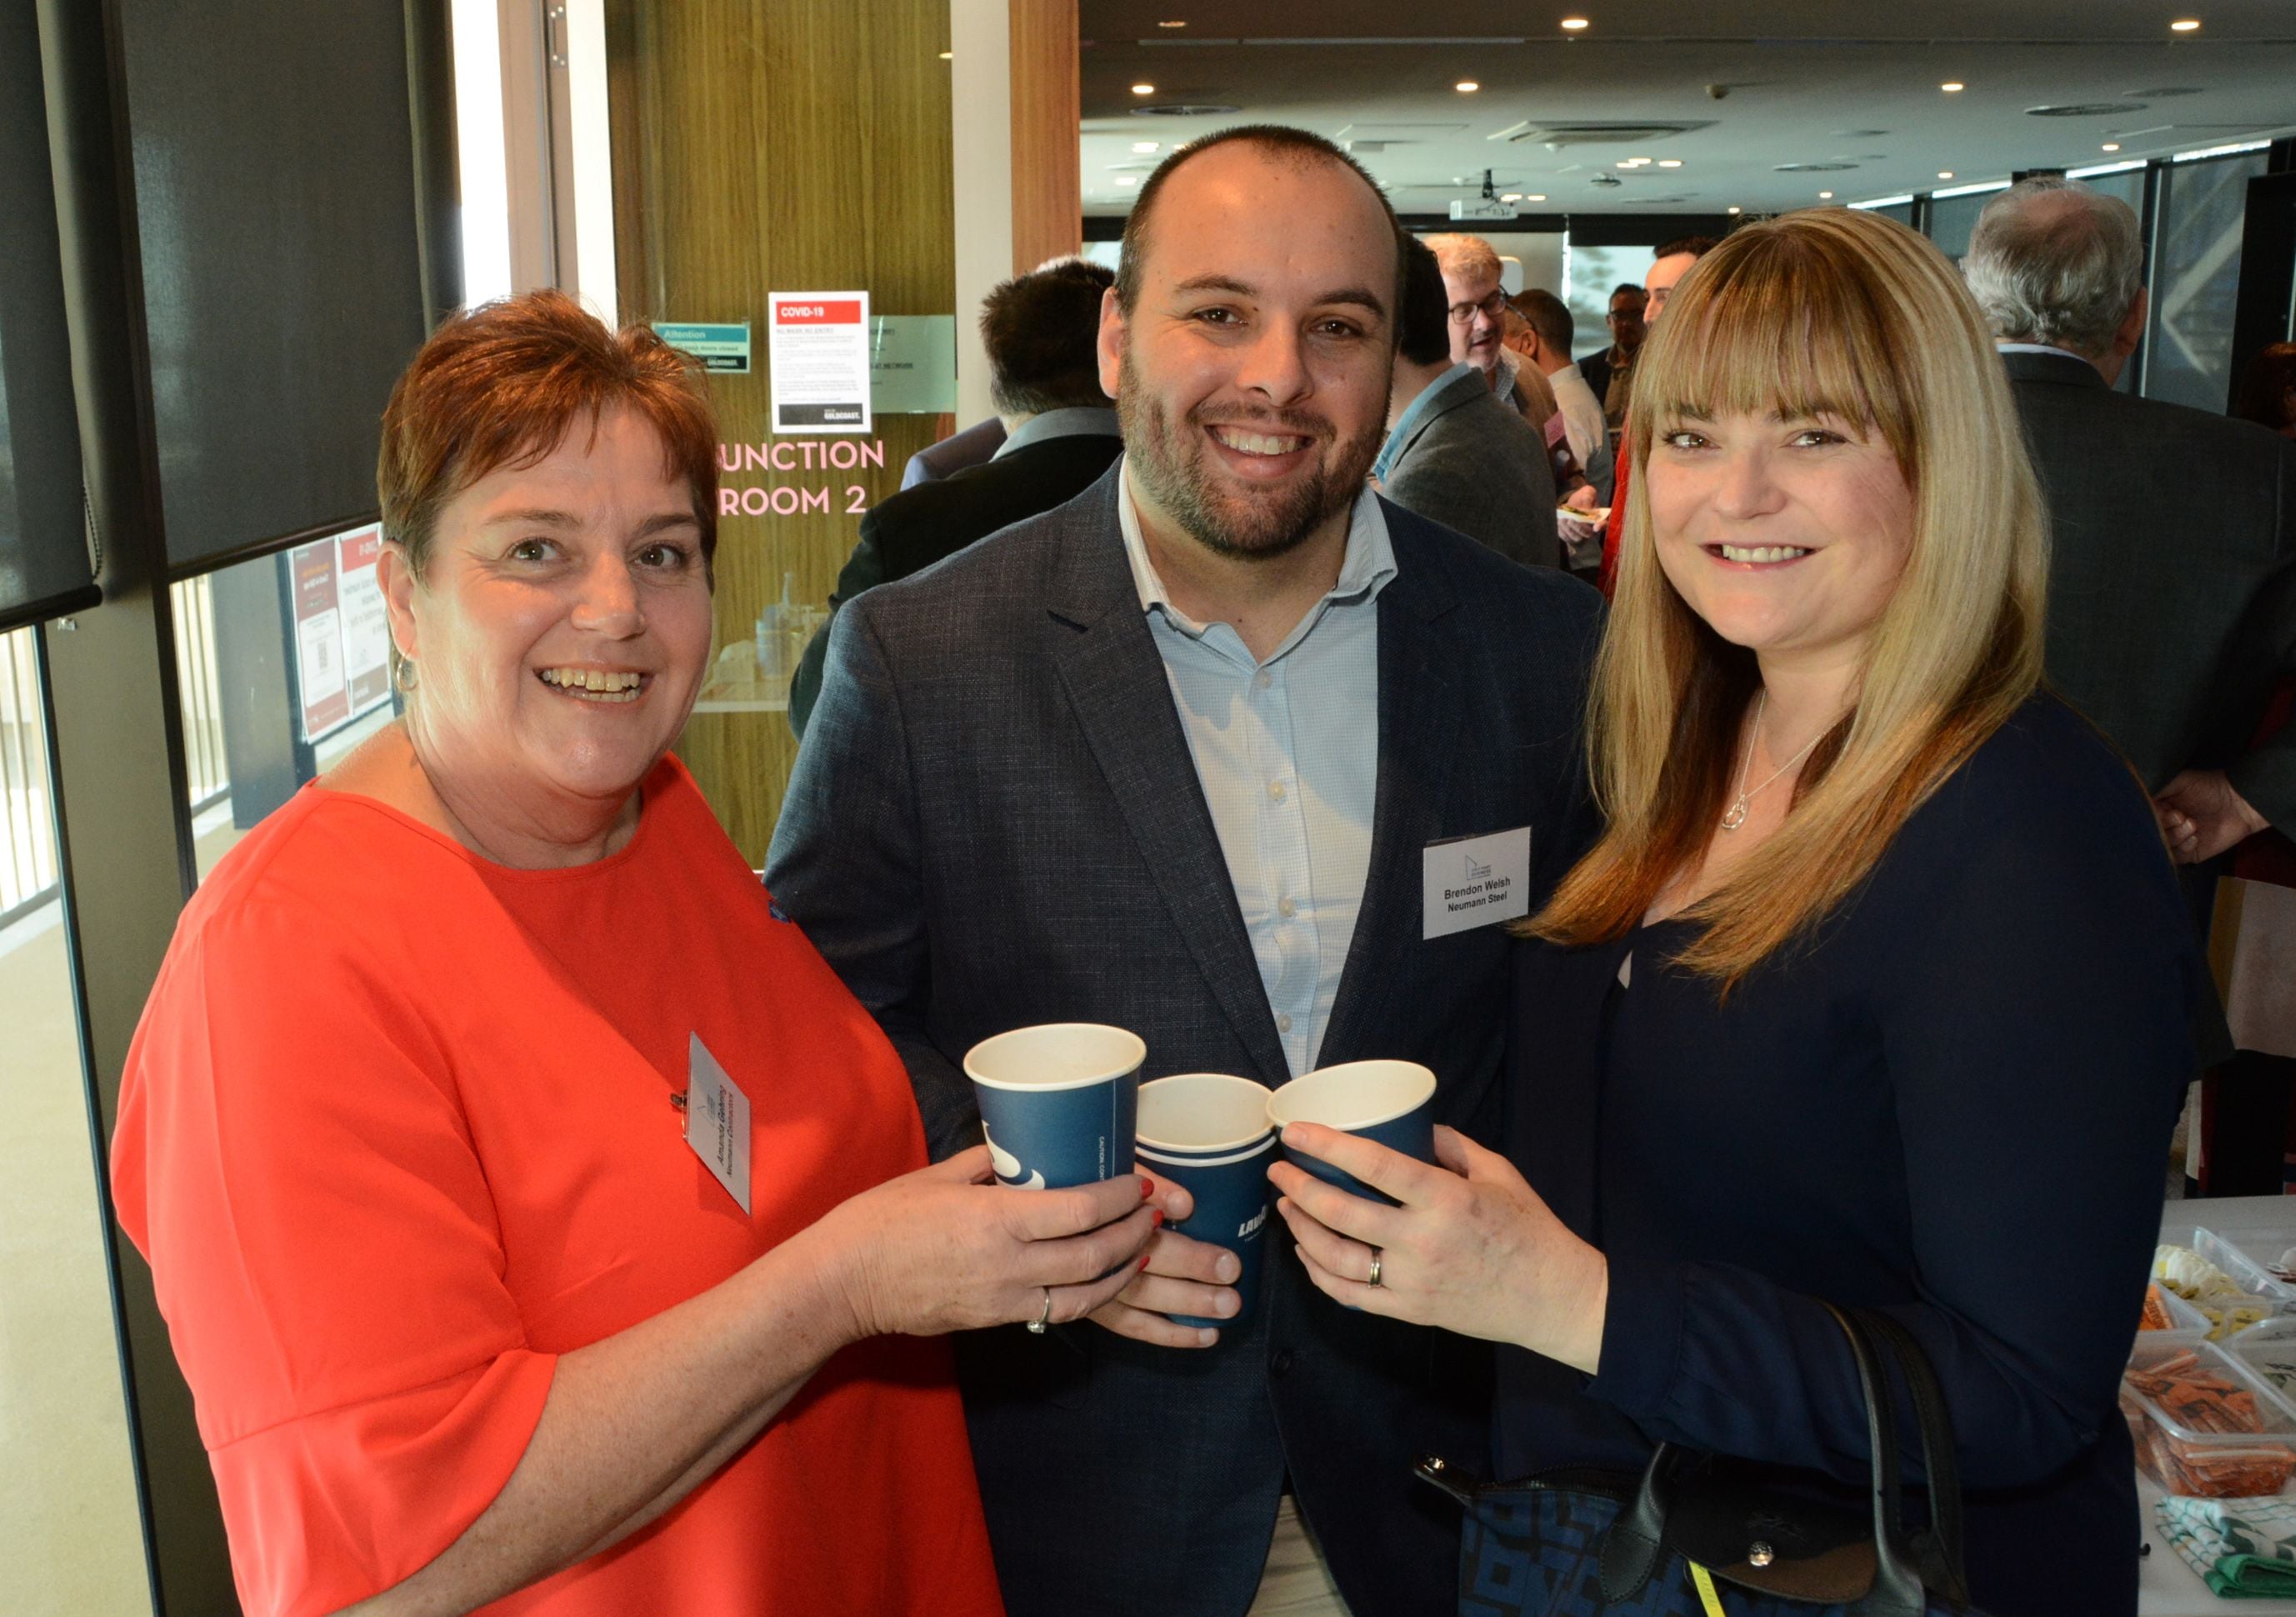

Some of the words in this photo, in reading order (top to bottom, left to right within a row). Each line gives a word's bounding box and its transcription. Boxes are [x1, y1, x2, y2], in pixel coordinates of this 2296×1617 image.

[781, 306, 824, 318] COVID-19
[663, 329, 707, 339] Attention
[720, 440, 884, 472] UNCTION
[719, 486, 829, 516] ROOM
[845, 485, 867, 513] 2
[1444, 884, 1483, 899] Brendon
[1484, 877, 1511, 891] Welsh
[1448, 898, 1486, 913] Neumann
[1488, 890, 1508, 904] Steel
[1238, 1204, 1268, 1238] LAVA
